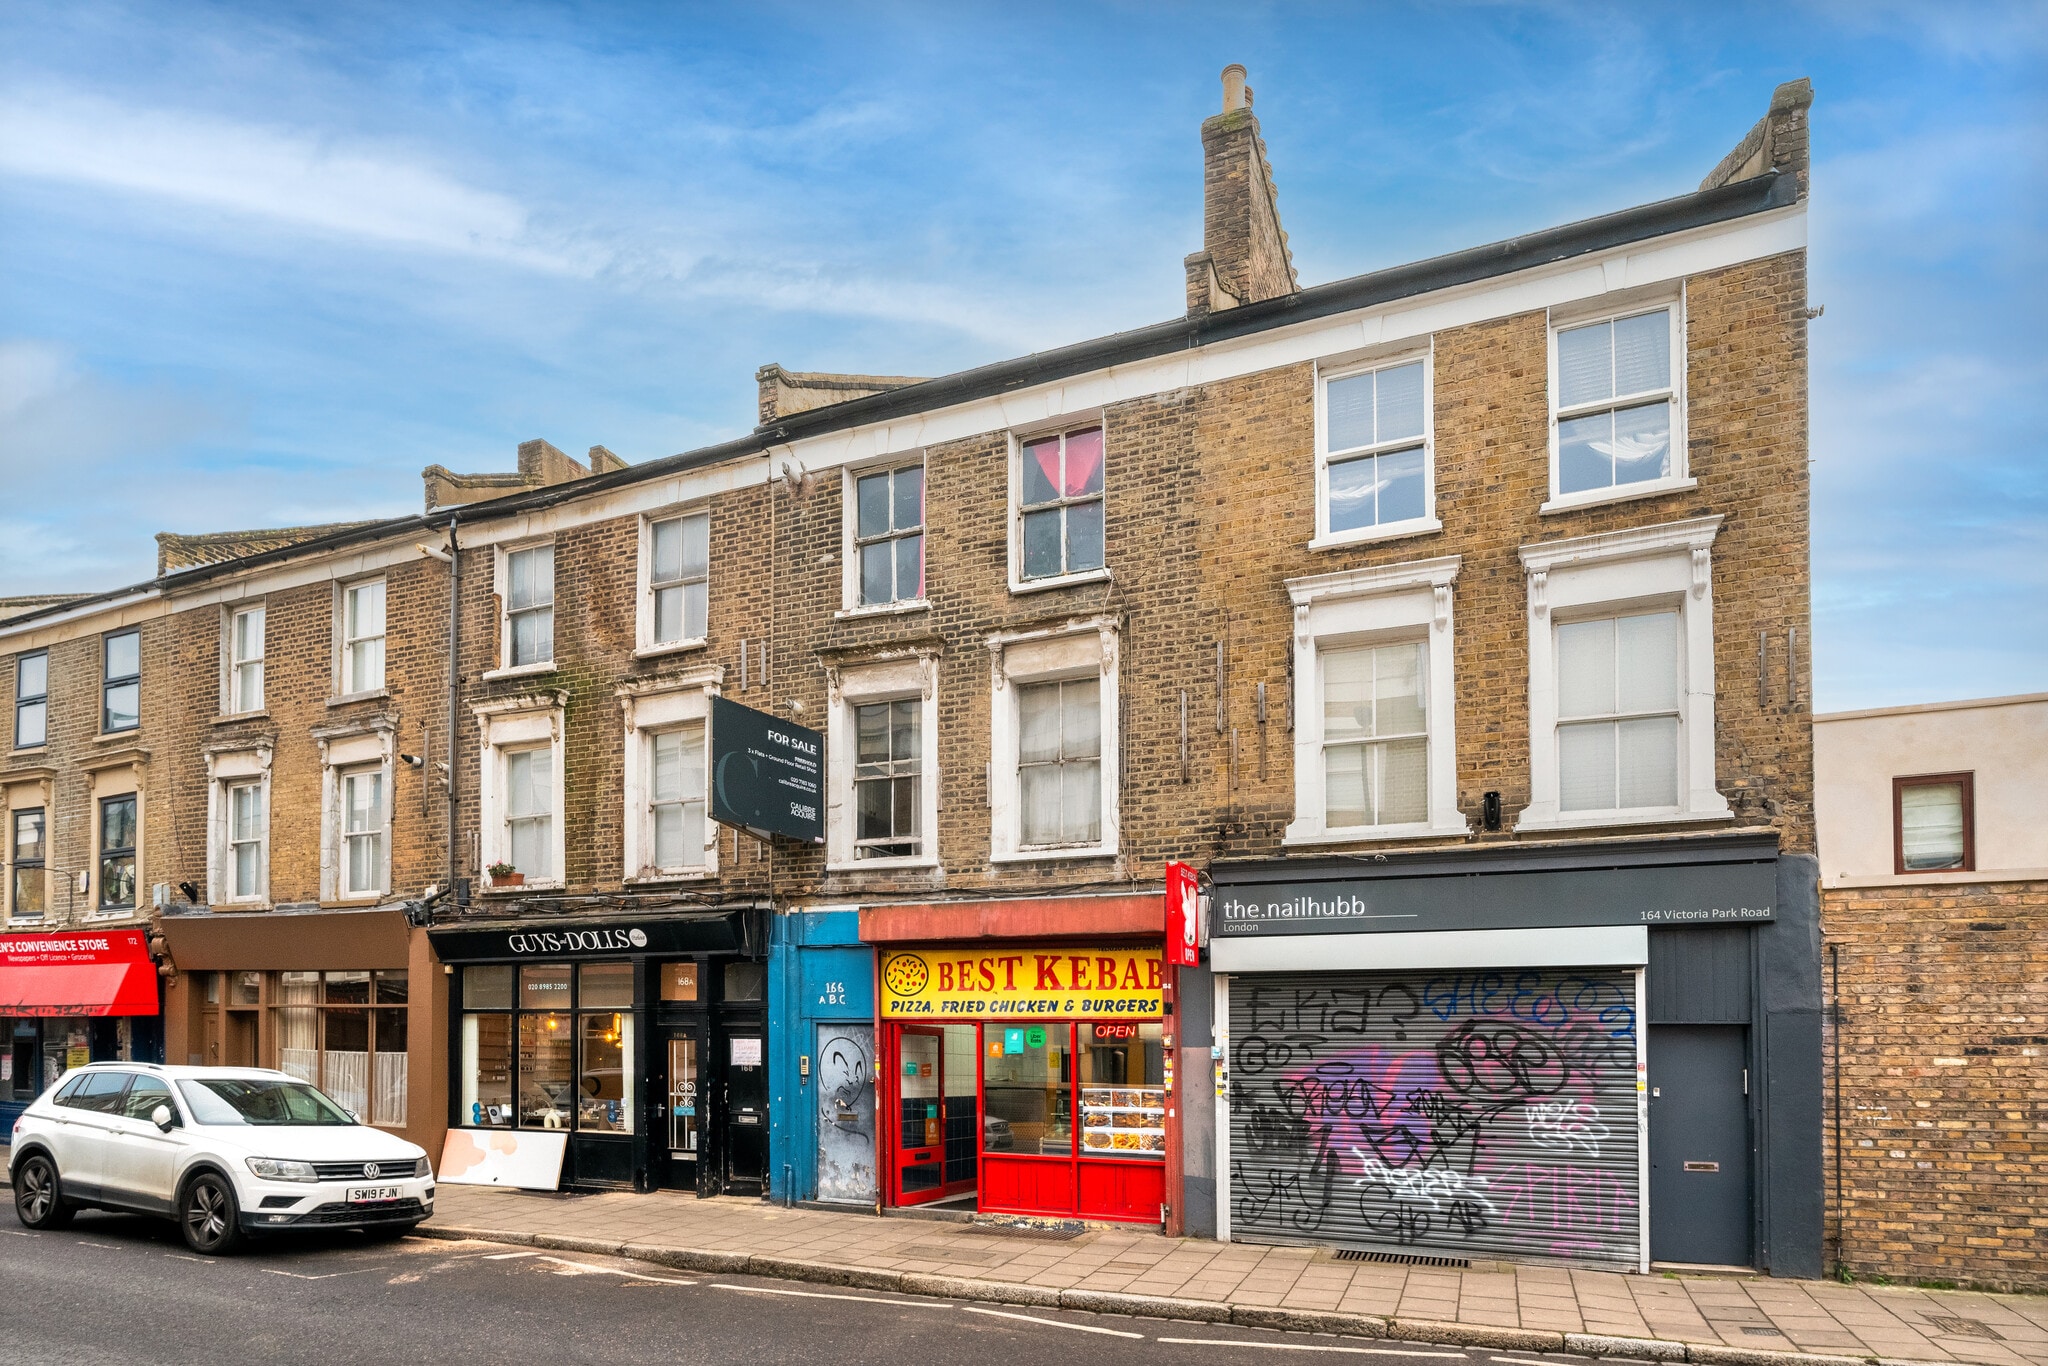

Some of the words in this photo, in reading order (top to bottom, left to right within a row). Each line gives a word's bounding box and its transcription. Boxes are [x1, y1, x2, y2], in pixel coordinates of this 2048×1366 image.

[768, 730, 789, 746] FOR
[791, 738, 817, 755] SALE
[768, 754, 784, 764] Ground
[790, 802, 816, 813] CALIBRE
[790, 809, 816, 821] ACQUIRE
[1223, 895, 1365, 919] the.nailhubb
[1641, 911, 1661, 920] 164
[1664, 909, 1709, 920] Victoria
[1712, 908, 1738, 918] Park
[1741, 906, 1770, 917] Road
[1224, 923, 1259, 932] London
[15, 940, 78, 952] CONVENIENCE
[79, 939, 110, 951] STORE
[127, 937, 138, 945] 172
[509, 933, 561, 952] GUYS
[564, 929, 630, 951] DOLLS
[8, 954, 37, 962] Newspapers
[40, 953, 48, 961] Off
[49, 953, 67, 961] Licence
[71, 952, 96, 961] Groceries
[1184, 948, 1195, 962] OPEN
[937, 955, 1023, 992] BEST
[1033, 954, 1163, 991] KEBAB
[678, 977, 694, 986] 168A
[825, 982, 845, 993] 166
[890, 1000, 934, 1014] PIZZA,
[941, 1000, 985, 1013] FRIED
[989, 1000, 1058, 1013] CHICKEN
[1064, 999, 1074, 1012] &
[1081, 999, 1160, 1013] BURGERS
[1095, 1025, 1136, 1038] OPEN
[354, 1189, 377, 1200] SW19
[378, 1187, 398, 1199] FJN
